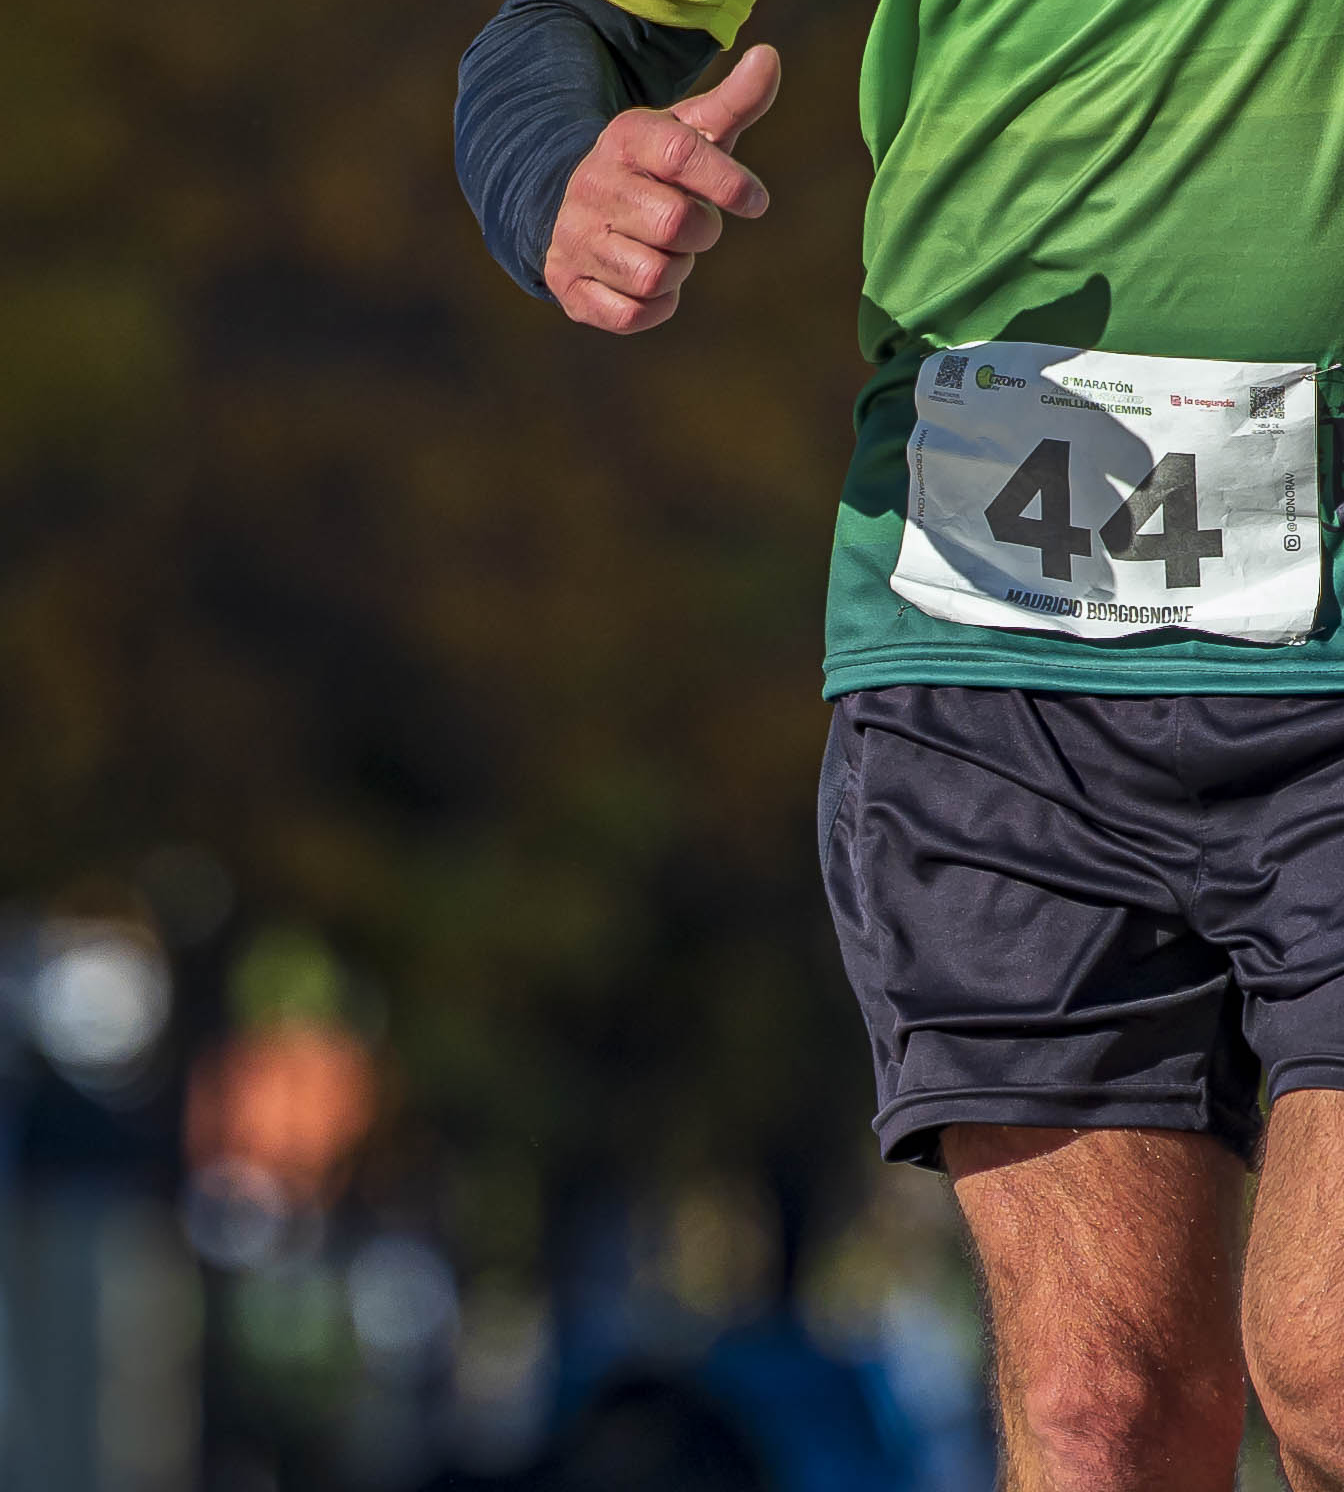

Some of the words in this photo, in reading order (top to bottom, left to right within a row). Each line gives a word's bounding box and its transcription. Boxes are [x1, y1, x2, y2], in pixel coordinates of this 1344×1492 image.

[1184, 395, 1194, 406] la
[1194, 397, 1236, 409] segunda
[983, 437, 1224, 589] 44
[1006, 588, 1084, 620] MAURICIO
[1085, 601, 1195, 624] BORGOGNONE
